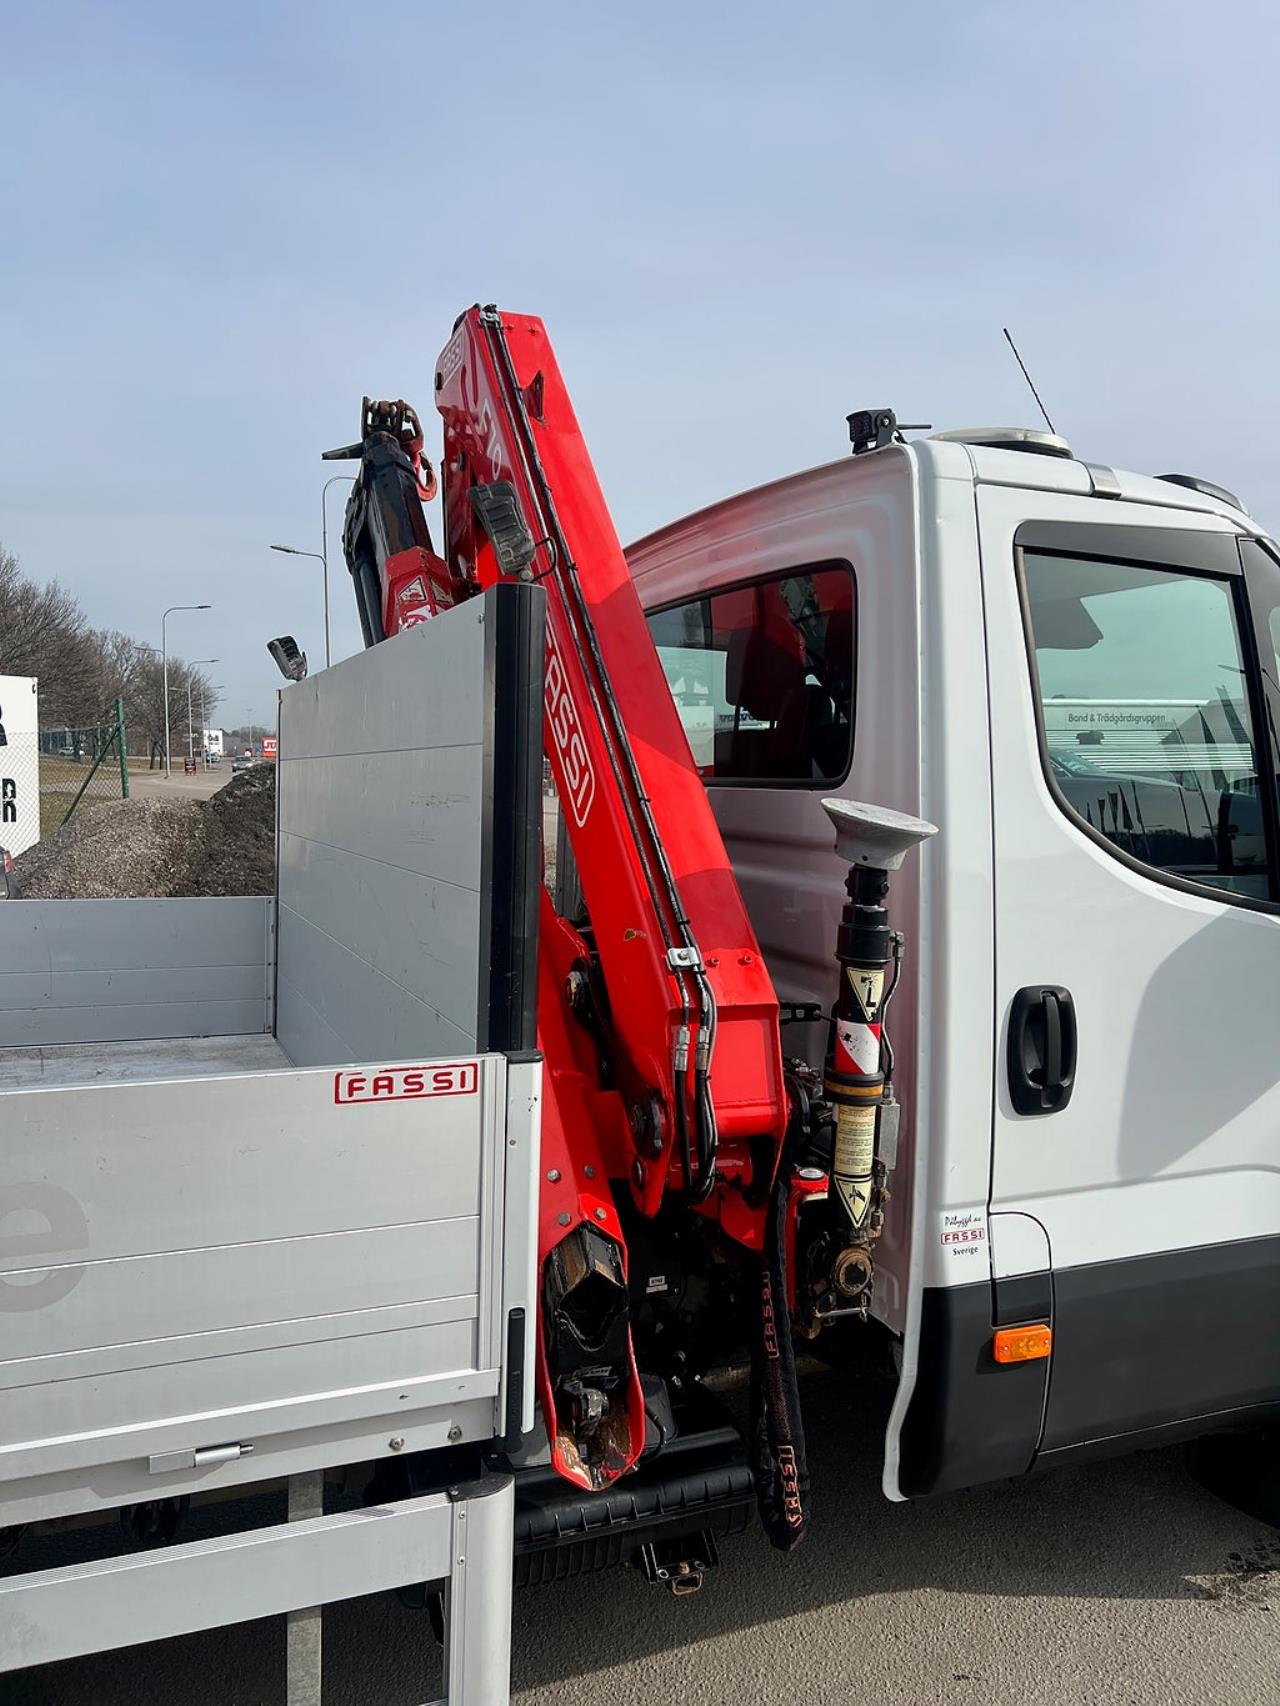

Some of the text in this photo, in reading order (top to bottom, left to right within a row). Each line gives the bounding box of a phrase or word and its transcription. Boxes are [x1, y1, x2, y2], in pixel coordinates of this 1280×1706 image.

[545, 620, 590, 809] ASSI
[1090, 713, 1096, 722] &
[347, 1070, 467, 1098] FASSI
[943, 1229, 983, 1243] FASSI
[952, 1246, 979, 1256] Sverige
[780, 1452, 799, 1522] FASSI
